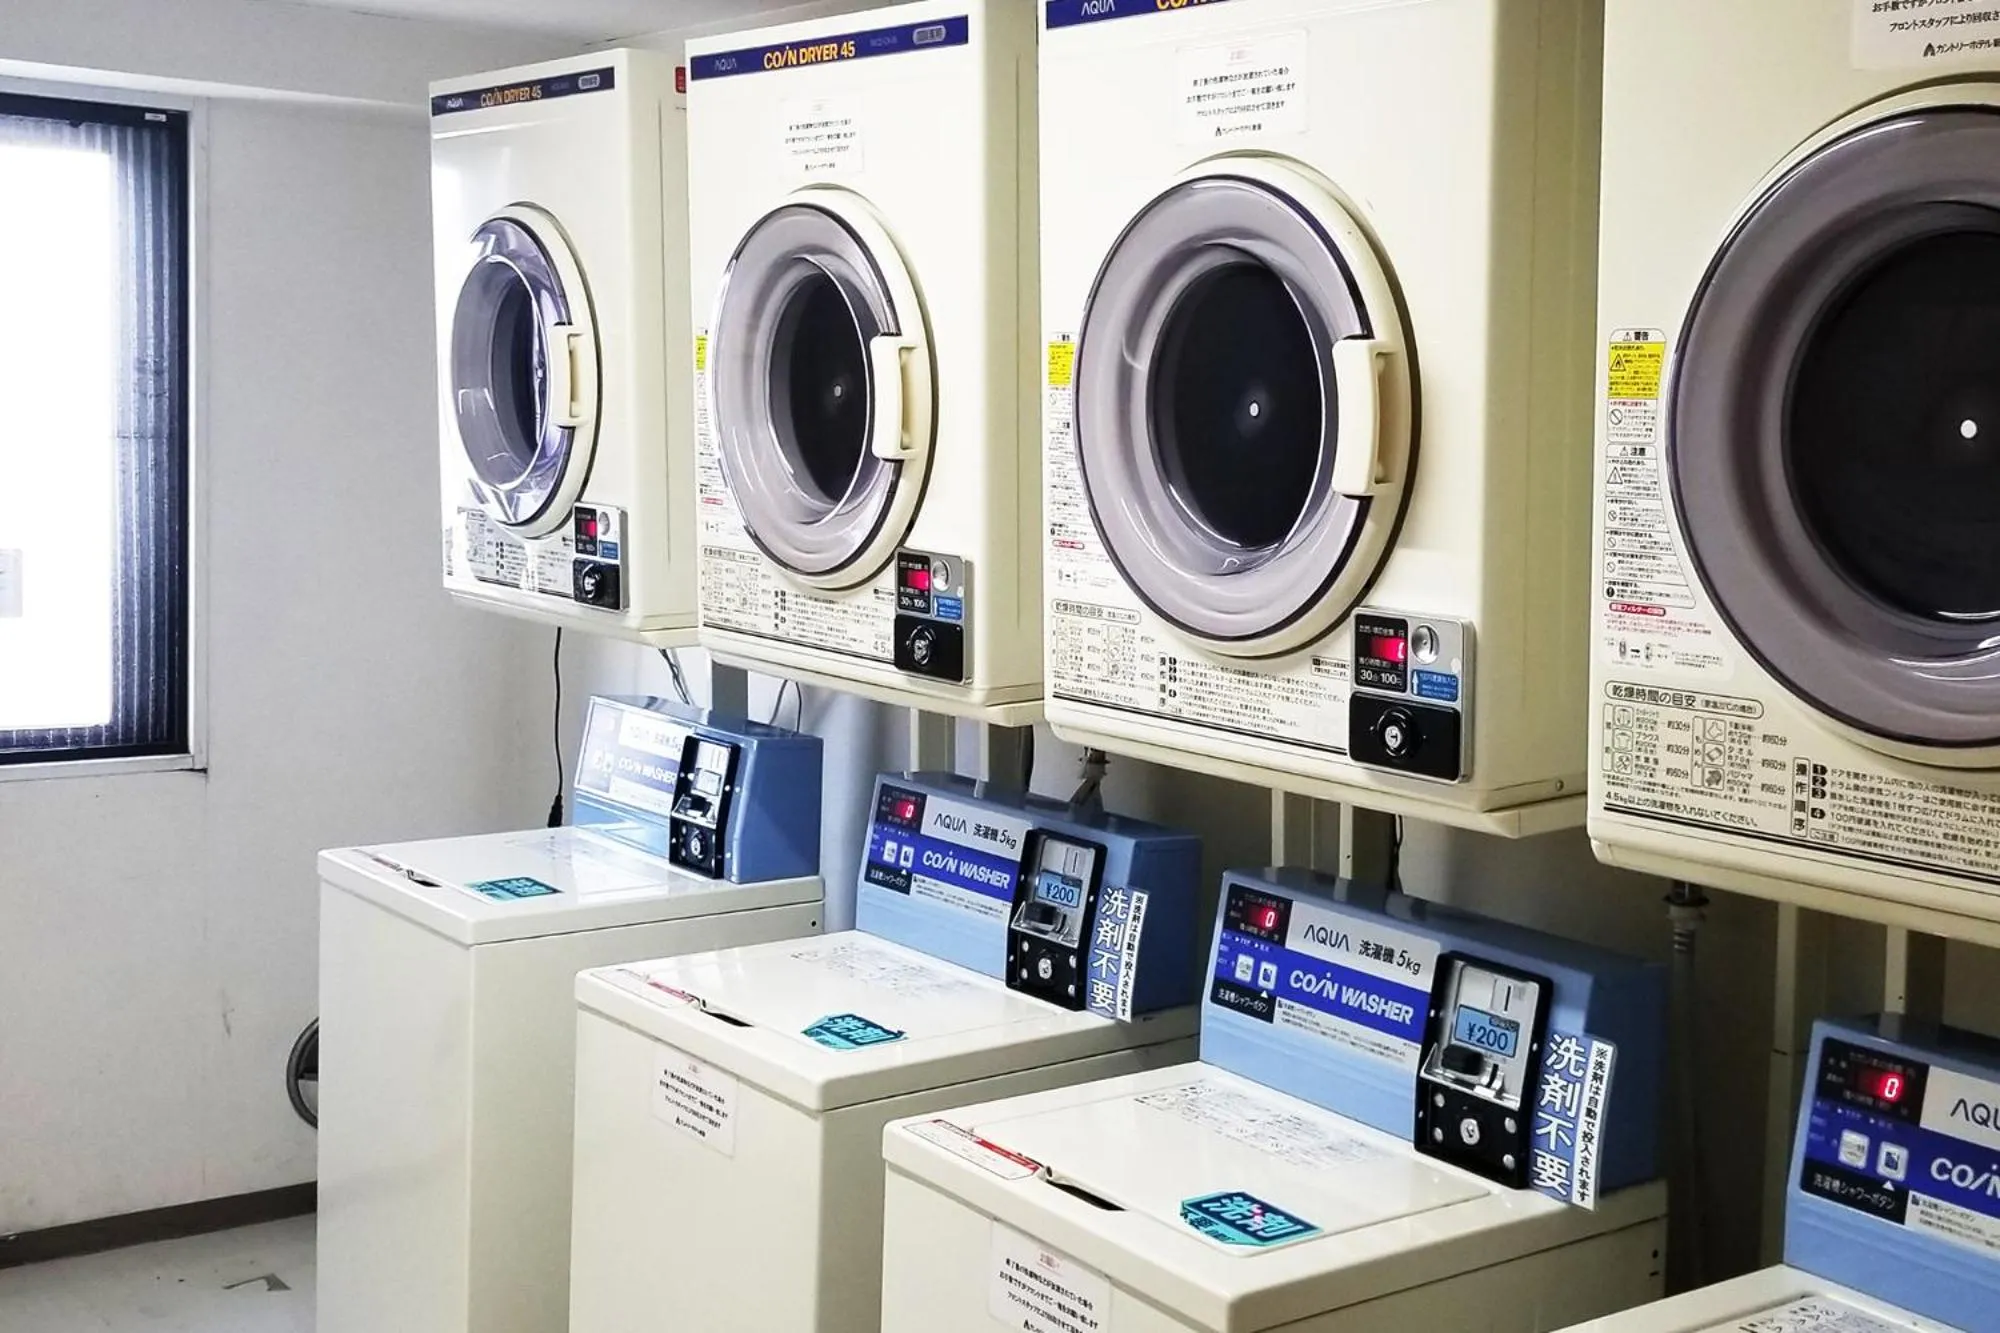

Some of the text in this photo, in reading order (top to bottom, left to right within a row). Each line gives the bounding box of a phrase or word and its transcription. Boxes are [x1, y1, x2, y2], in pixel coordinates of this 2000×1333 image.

[1081, 0, 1115, 16] AQUA
[715, 56, 738, 72] AQUA
[799, 46, 838, 65] DRYER
[840, 40, 856, 58] 45
[502, 87, 530, 104] DRYER
[531, 84, 543, 100] 45
[1631, 446, 1647, 457] 注意
[1612, 685, 1697, 708] 乾燥時間の目安
[904, 805, 914, 819] 0
[934, 813, 968, 834] AQUA
[999, 828, 1017, 849] 5kg
[959, 860, 1011, 890] WASHER
[1045, 881, 1074, 904] ¥200
[1264, 911, 1275, 928] 0
[1091, 887, 1129, 1013] 洗剤不要
[1303, 924, 1422, 976] AQUA 洗濯機 5kg
[1341, 985, 1415, 1025] WASHER
[1465, 1021, 1510, 1051] ¥200
[1884, 1077, 1900, 1099] 0
[1533, 1033, 1588, 1197] 洗剤不要
[1576, 1046, 1608, 1202] ※洗剤は自動で投入されます
[1201, 1196, 1305, 1237] 洗剤
